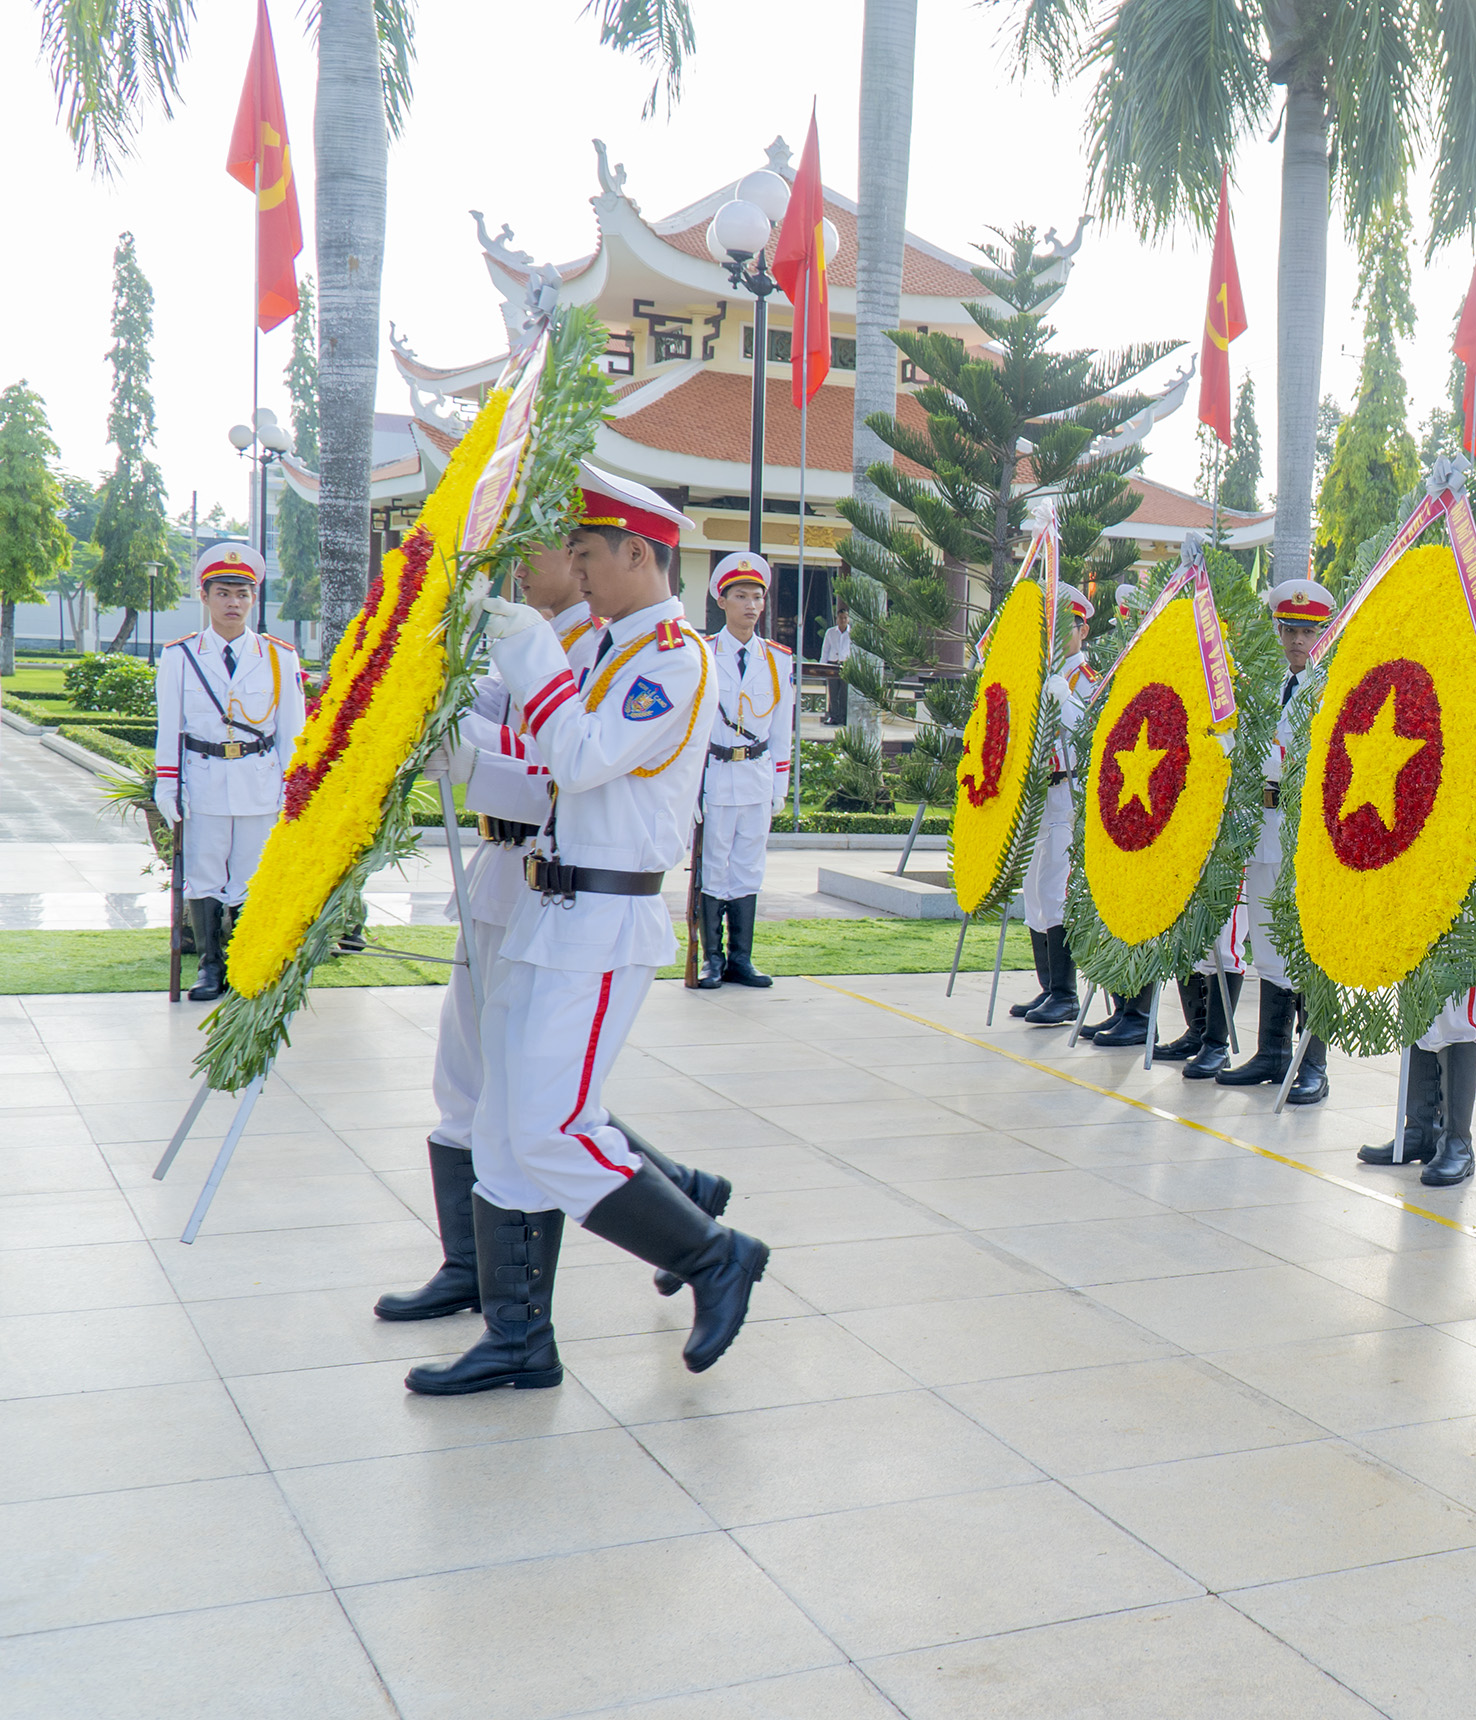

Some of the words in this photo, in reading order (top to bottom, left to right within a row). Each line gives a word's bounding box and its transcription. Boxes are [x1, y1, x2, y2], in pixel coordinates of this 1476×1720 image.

[1424, 502, 1431, 516] 7
[1455, 518, 1473, 544] Đời
[1198, 588, 1217, 643] Kính
[1208, 642, 1230, 710] Viếng
